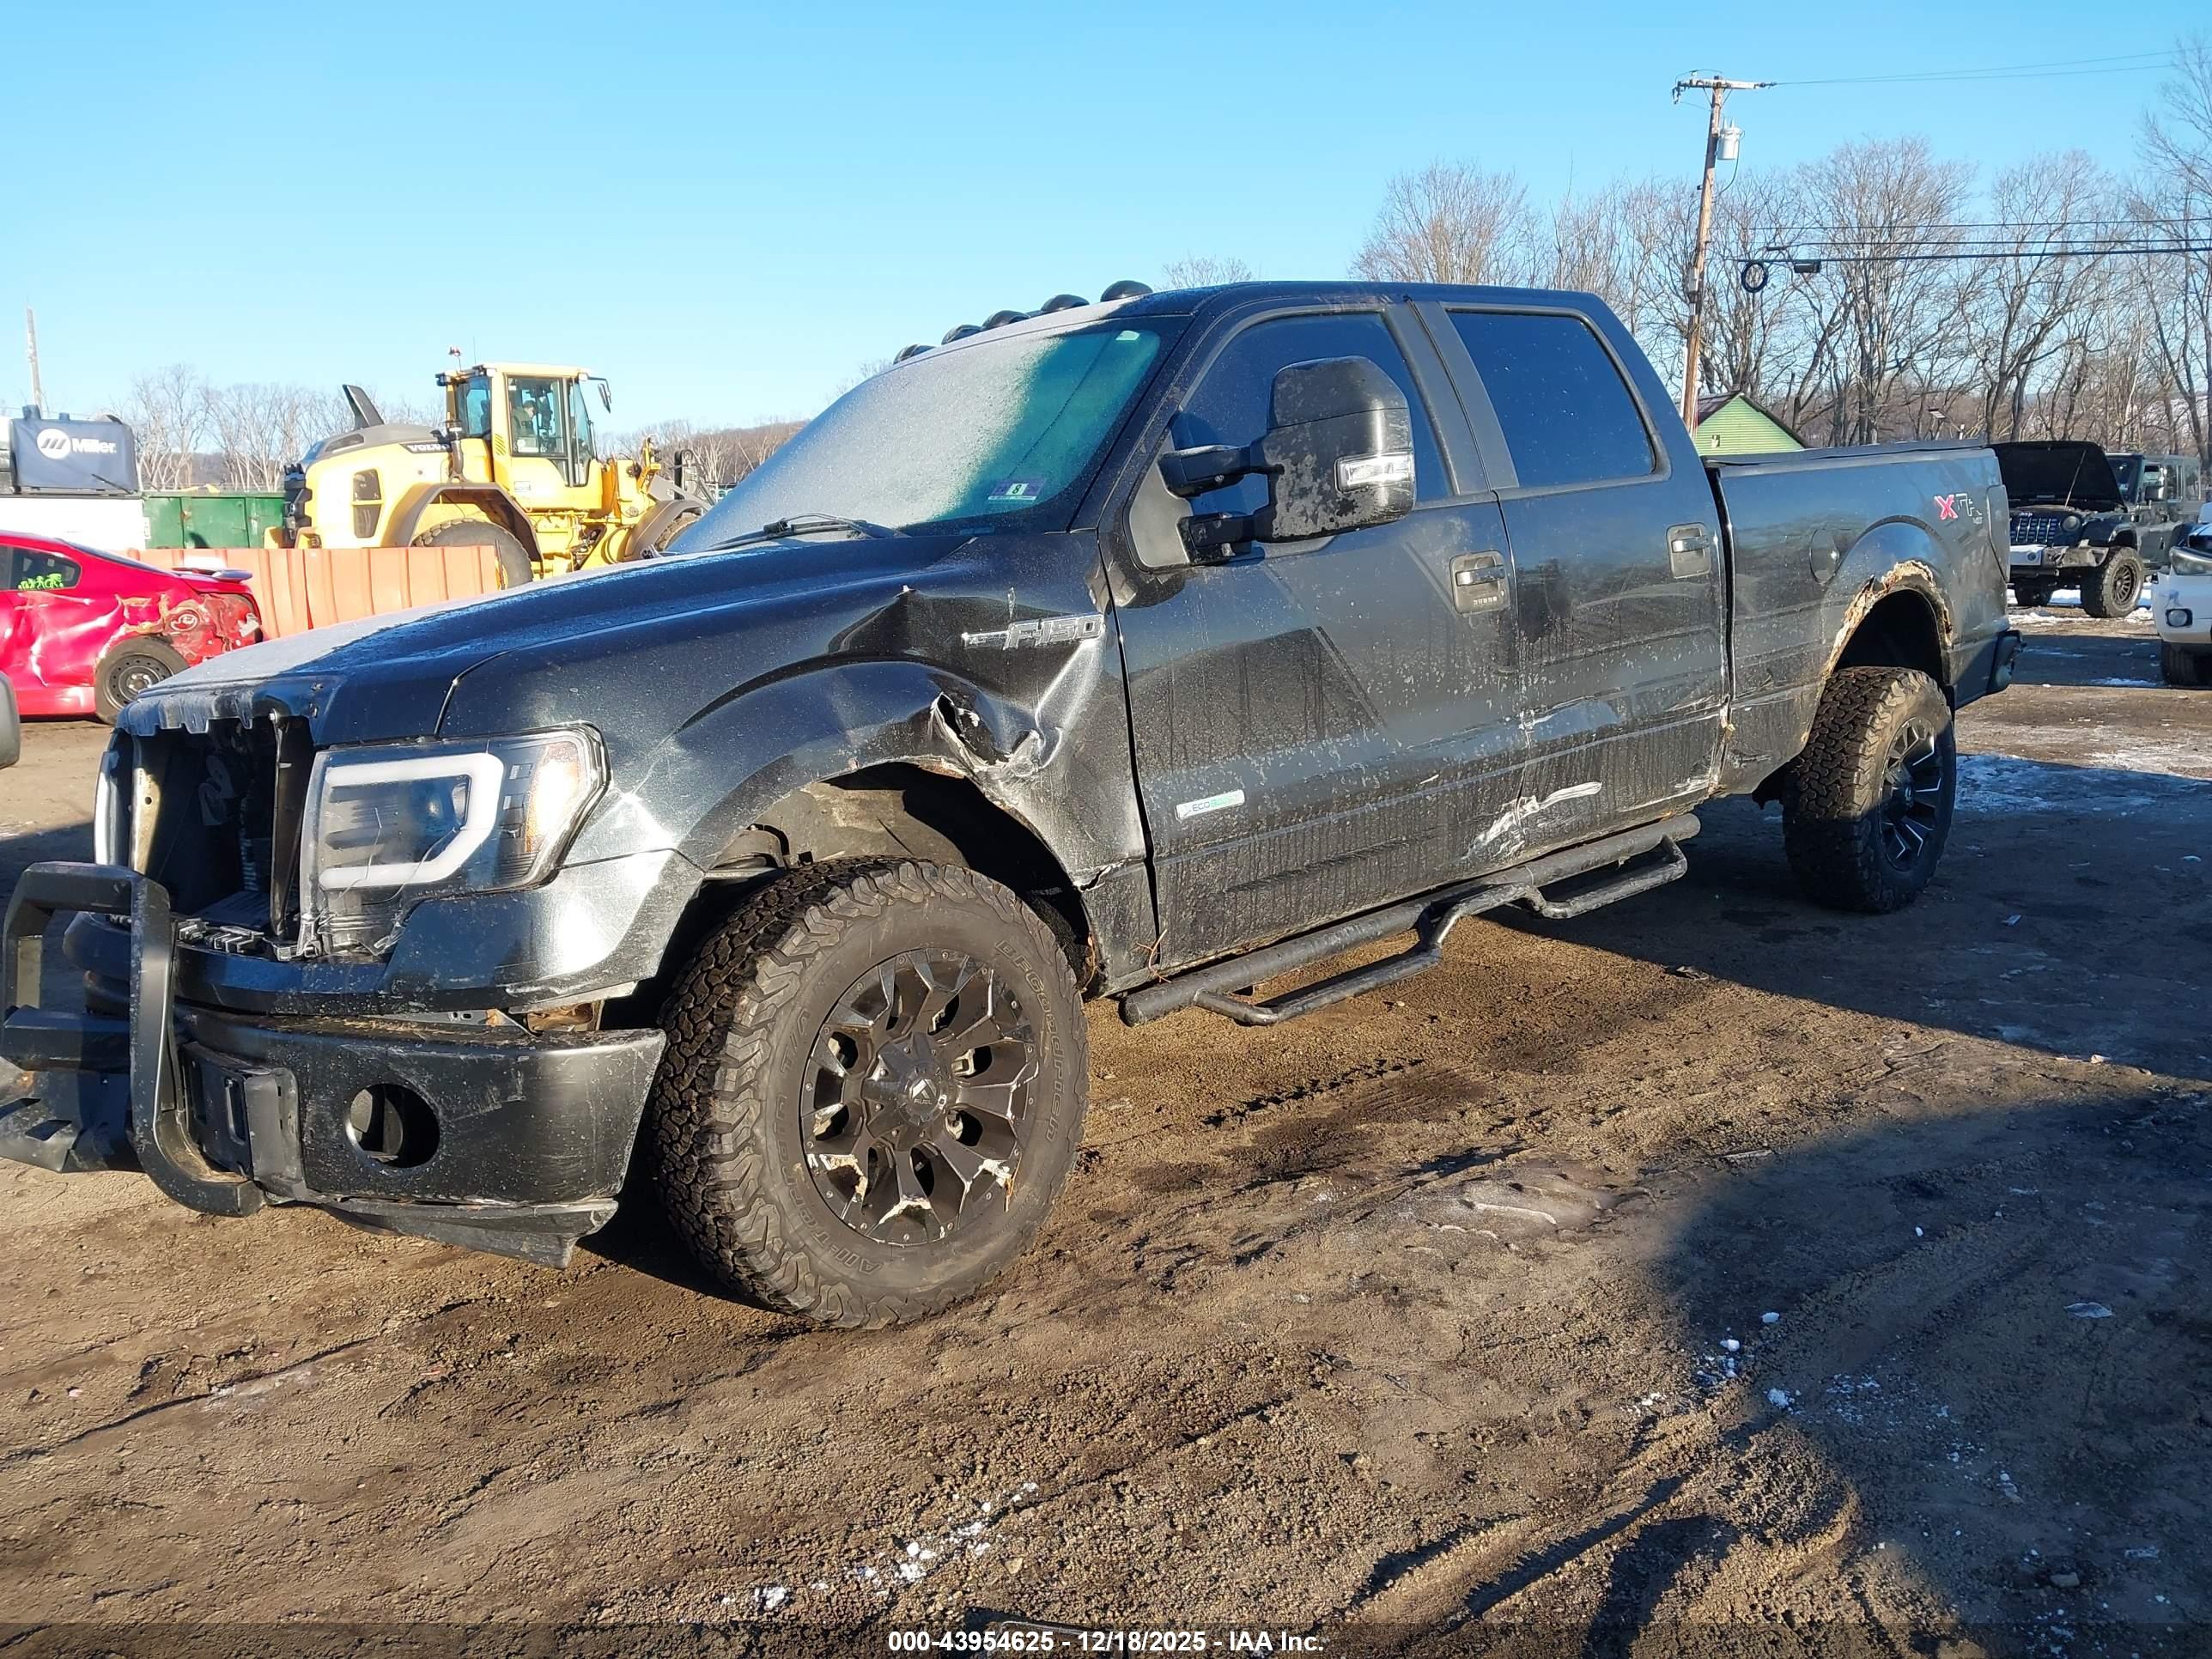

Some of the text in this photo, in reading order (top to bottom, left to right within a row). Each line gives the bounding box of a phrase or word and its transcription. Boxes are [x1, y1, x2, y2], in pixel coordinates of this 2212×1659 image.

[71, 438, 117, 453] Miller
[1012, 483, 1023, 495] 8
[1003, 613, 1104, 650] F-150
[995, 939, 1066, 1144] BFGoodrich
